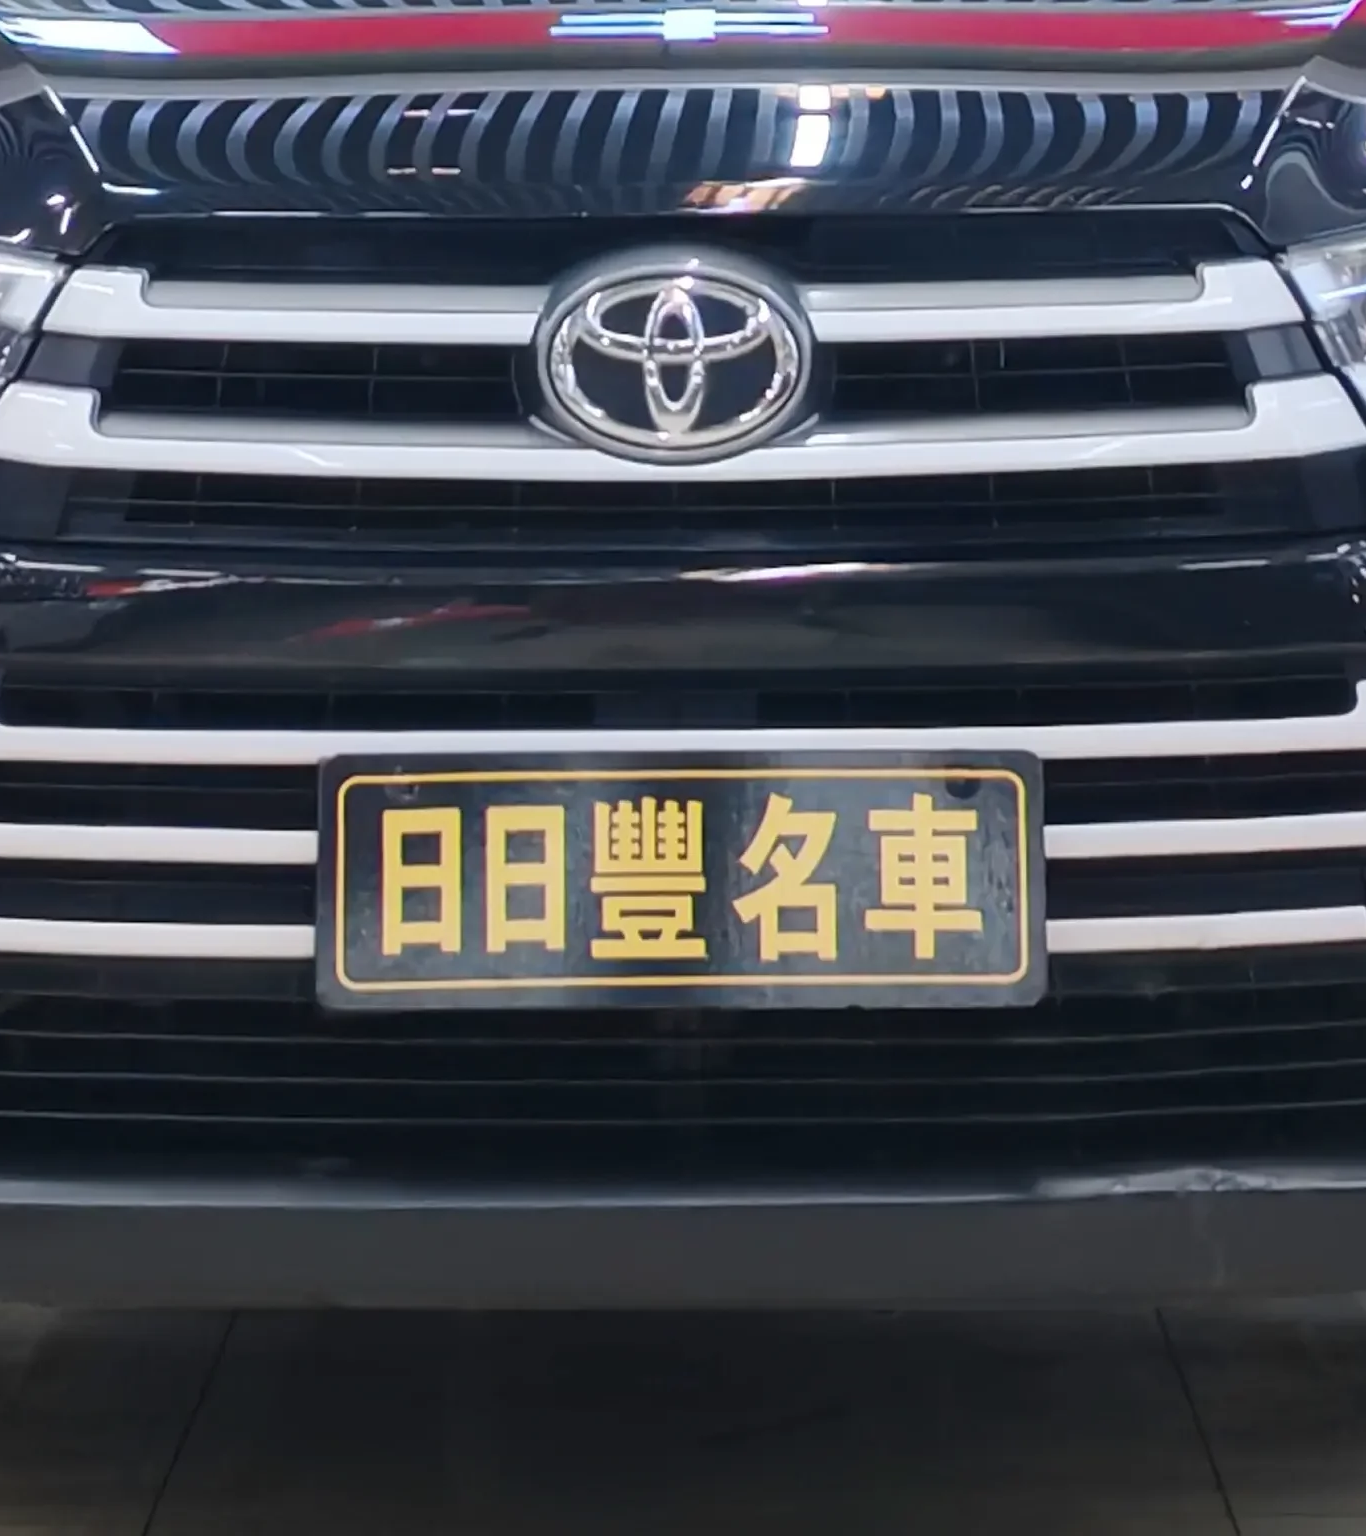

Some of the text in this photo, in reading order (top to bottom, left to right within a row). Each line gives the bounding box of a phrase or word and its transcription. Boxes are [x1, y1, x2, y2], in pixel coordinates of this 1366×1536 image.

[380, 792, 982, 961] 日日豐名車
